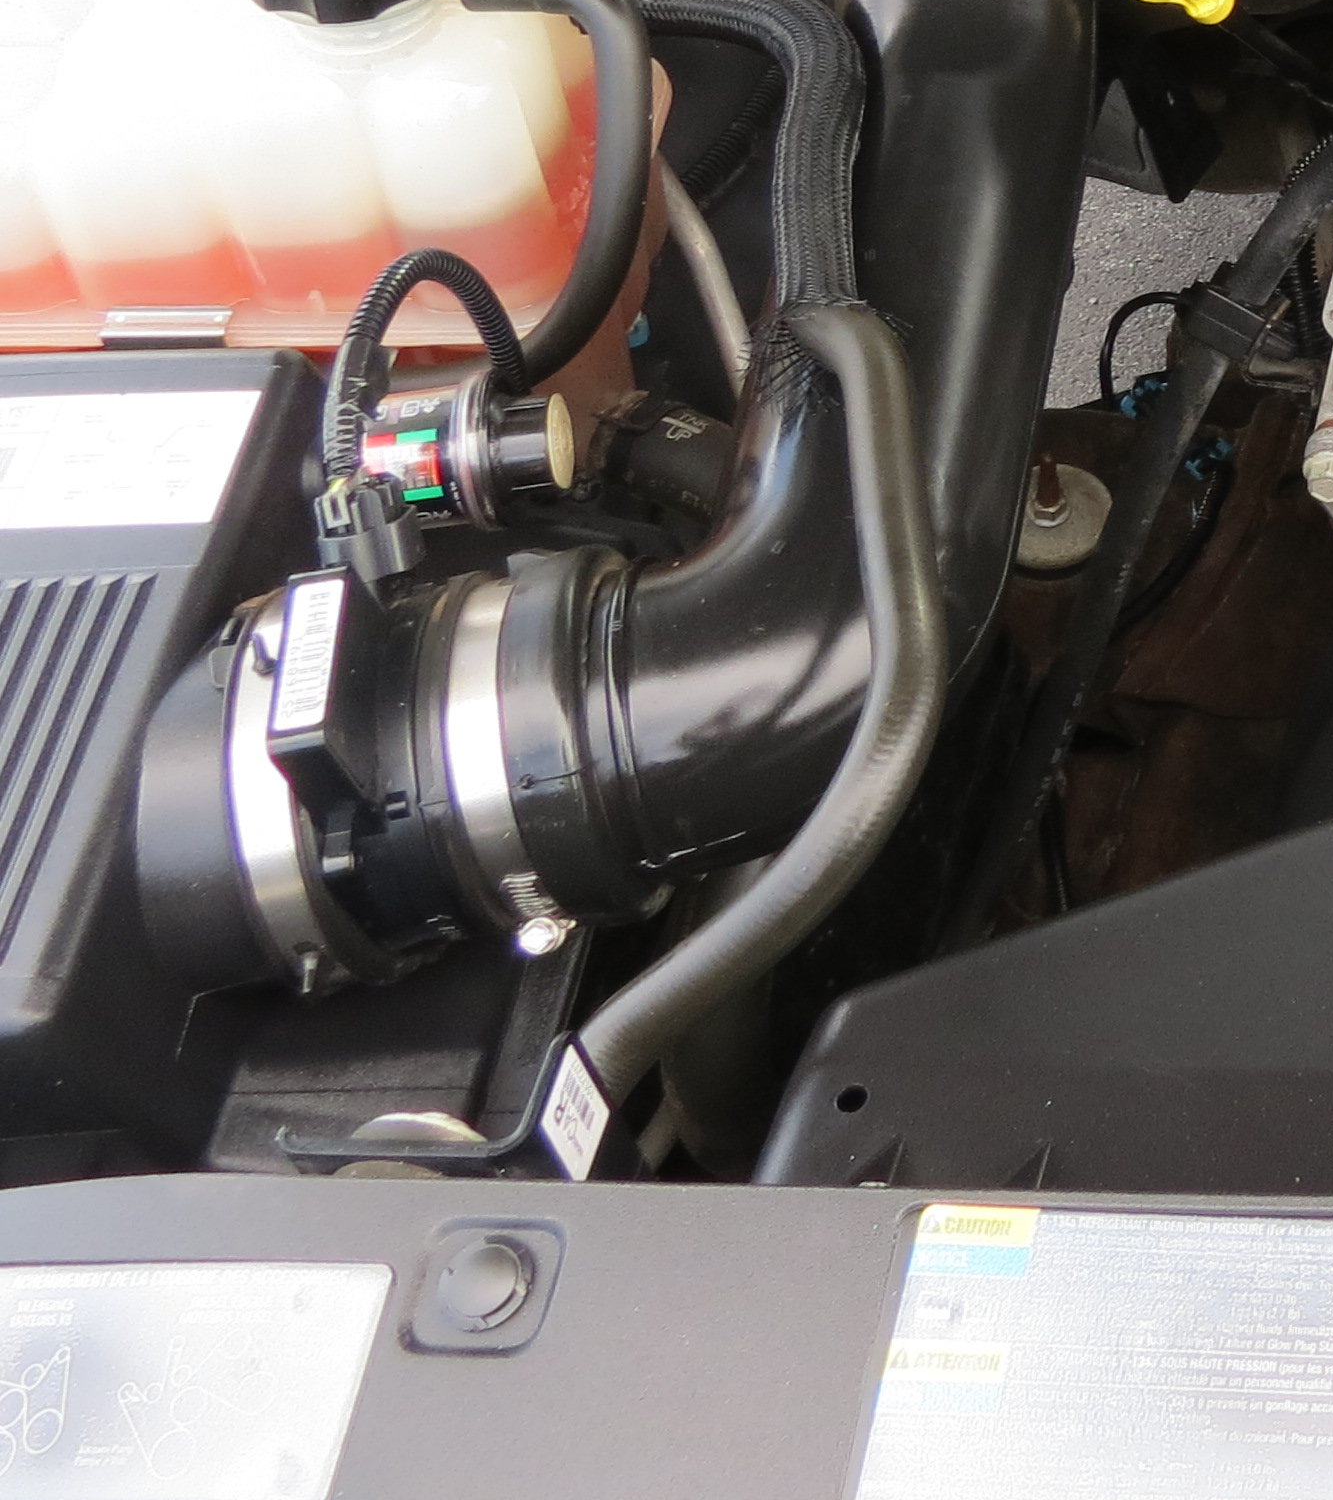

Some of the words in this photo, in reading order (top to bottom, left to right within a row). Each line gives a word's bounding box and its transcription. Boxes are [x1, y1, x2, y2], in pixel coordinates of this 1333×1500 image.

[944, 1215, 1012, 1237] CAUTION
[1078, 1215, 1148, 1231] REFRIGERANT
[1149, 1218, 1184, 1232] UNDER
[1185, 1220, 1210, 1233] HIGH
[1212, 1222, 1265, 1236] PRESSURE
[1267, 1339, 1292, 1350] Glow
[1294, 1340, 1317, 1354] Plug
[914, 1351, 1000, 1371] ATTENTION
[1160, 1356, 1187, 1370] SOUS
[1190, 1357, 1222, 1371] HAUTE
[1225, 1359, 1277, 1372] PRESSION
[1278, 1362, 1304, 1377] (pour
[1307, 1362, 1322, 1375] les
[1244, 1376, 1294, 1391] personnel
[1291, 1433, 1314, 1445] Pour
